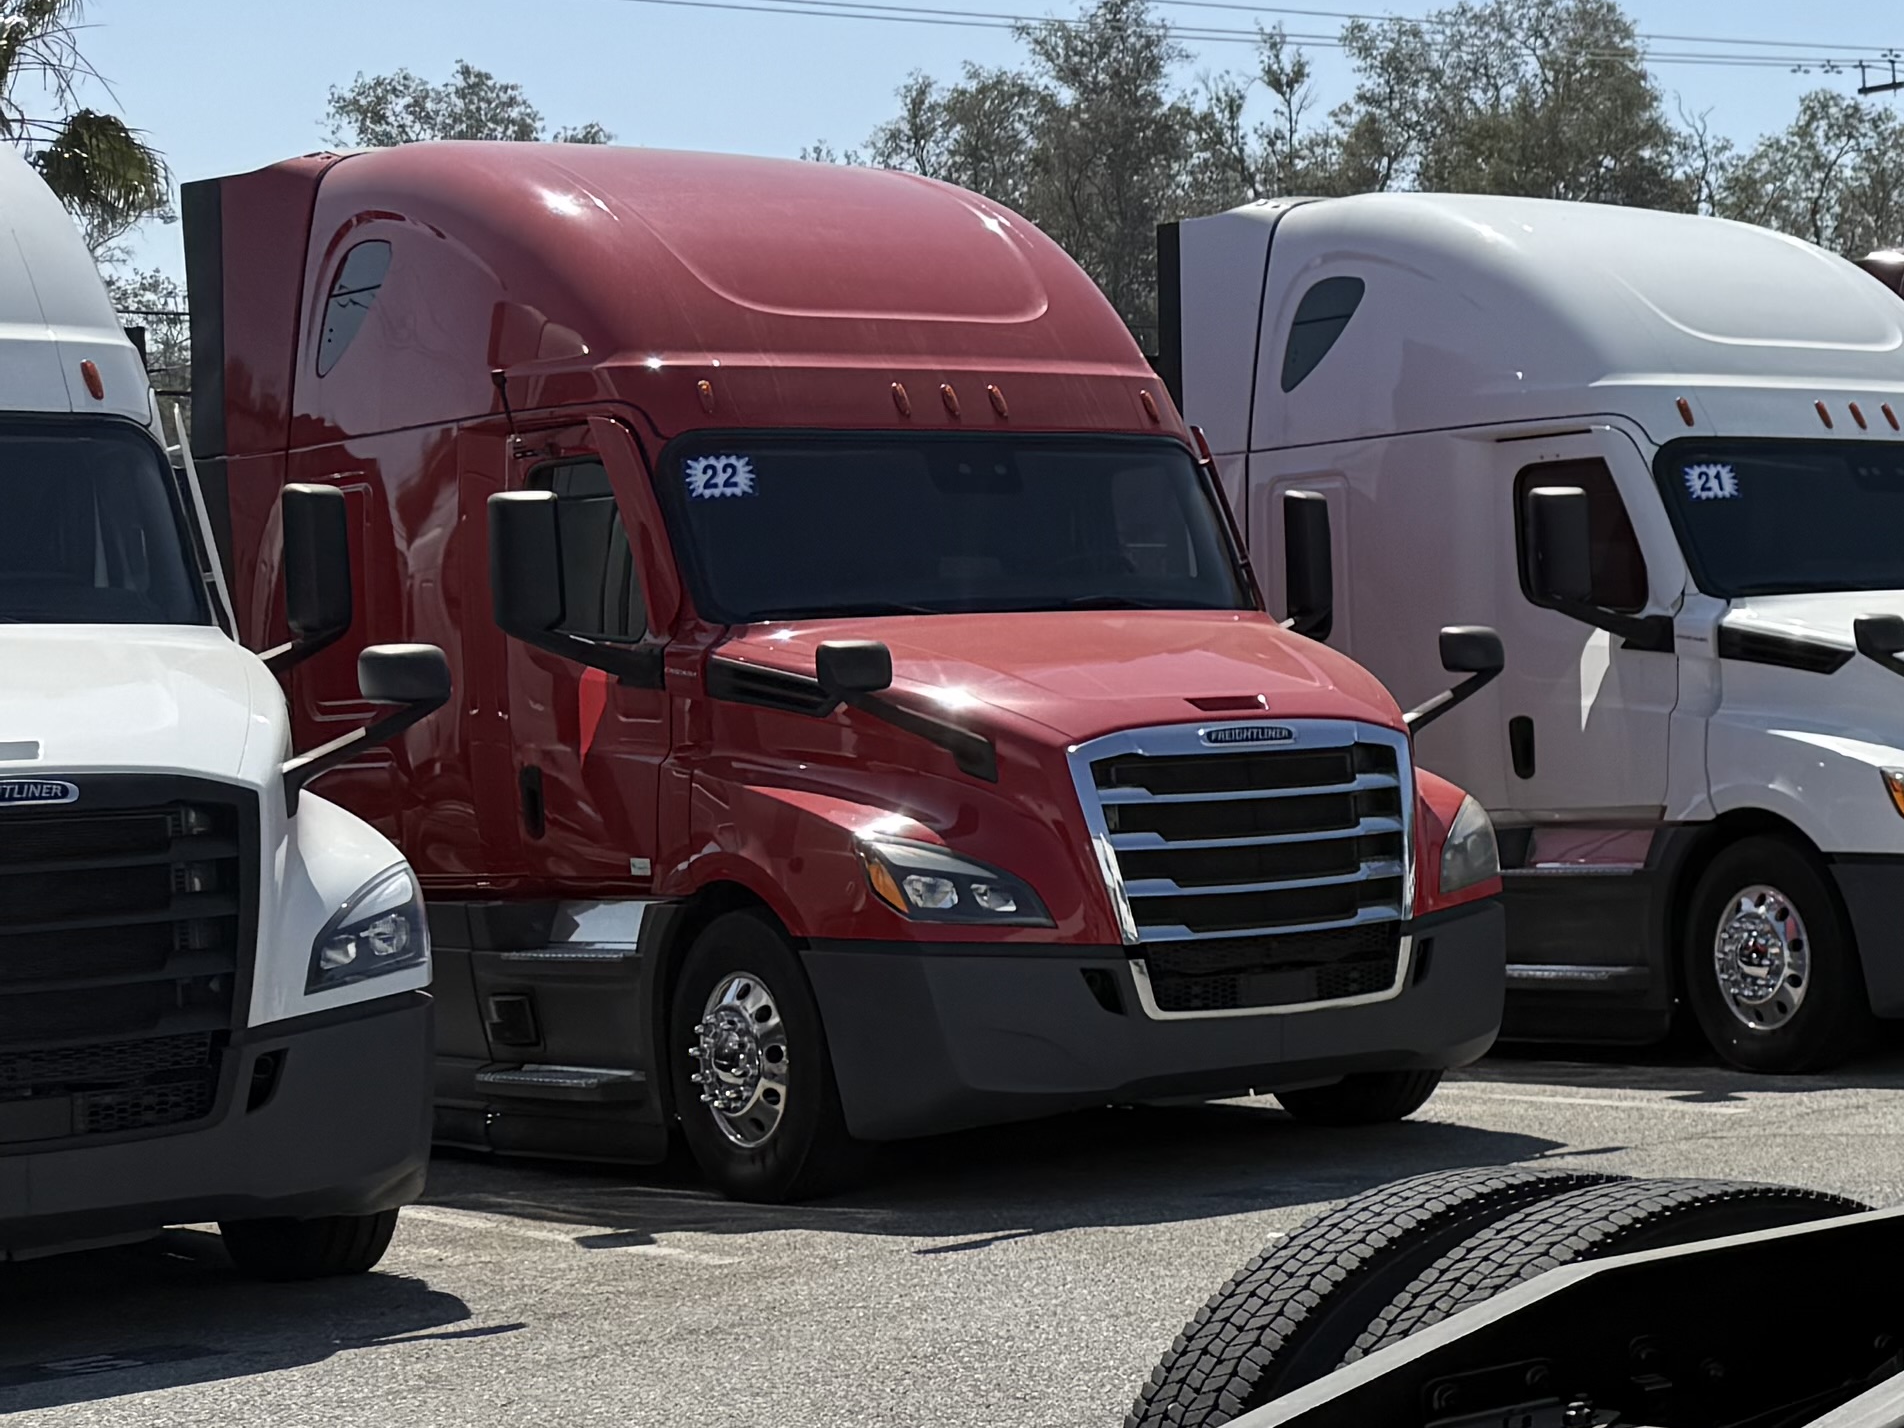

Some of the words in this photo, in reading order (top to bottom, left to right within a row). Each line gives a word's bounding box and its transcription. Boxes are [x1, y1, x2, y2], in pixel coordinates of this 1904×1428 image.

[702, 463, 738, 490] 22
[1698, 470, 1724, 492] 21
[0, 784, 62, 799] TLINER
